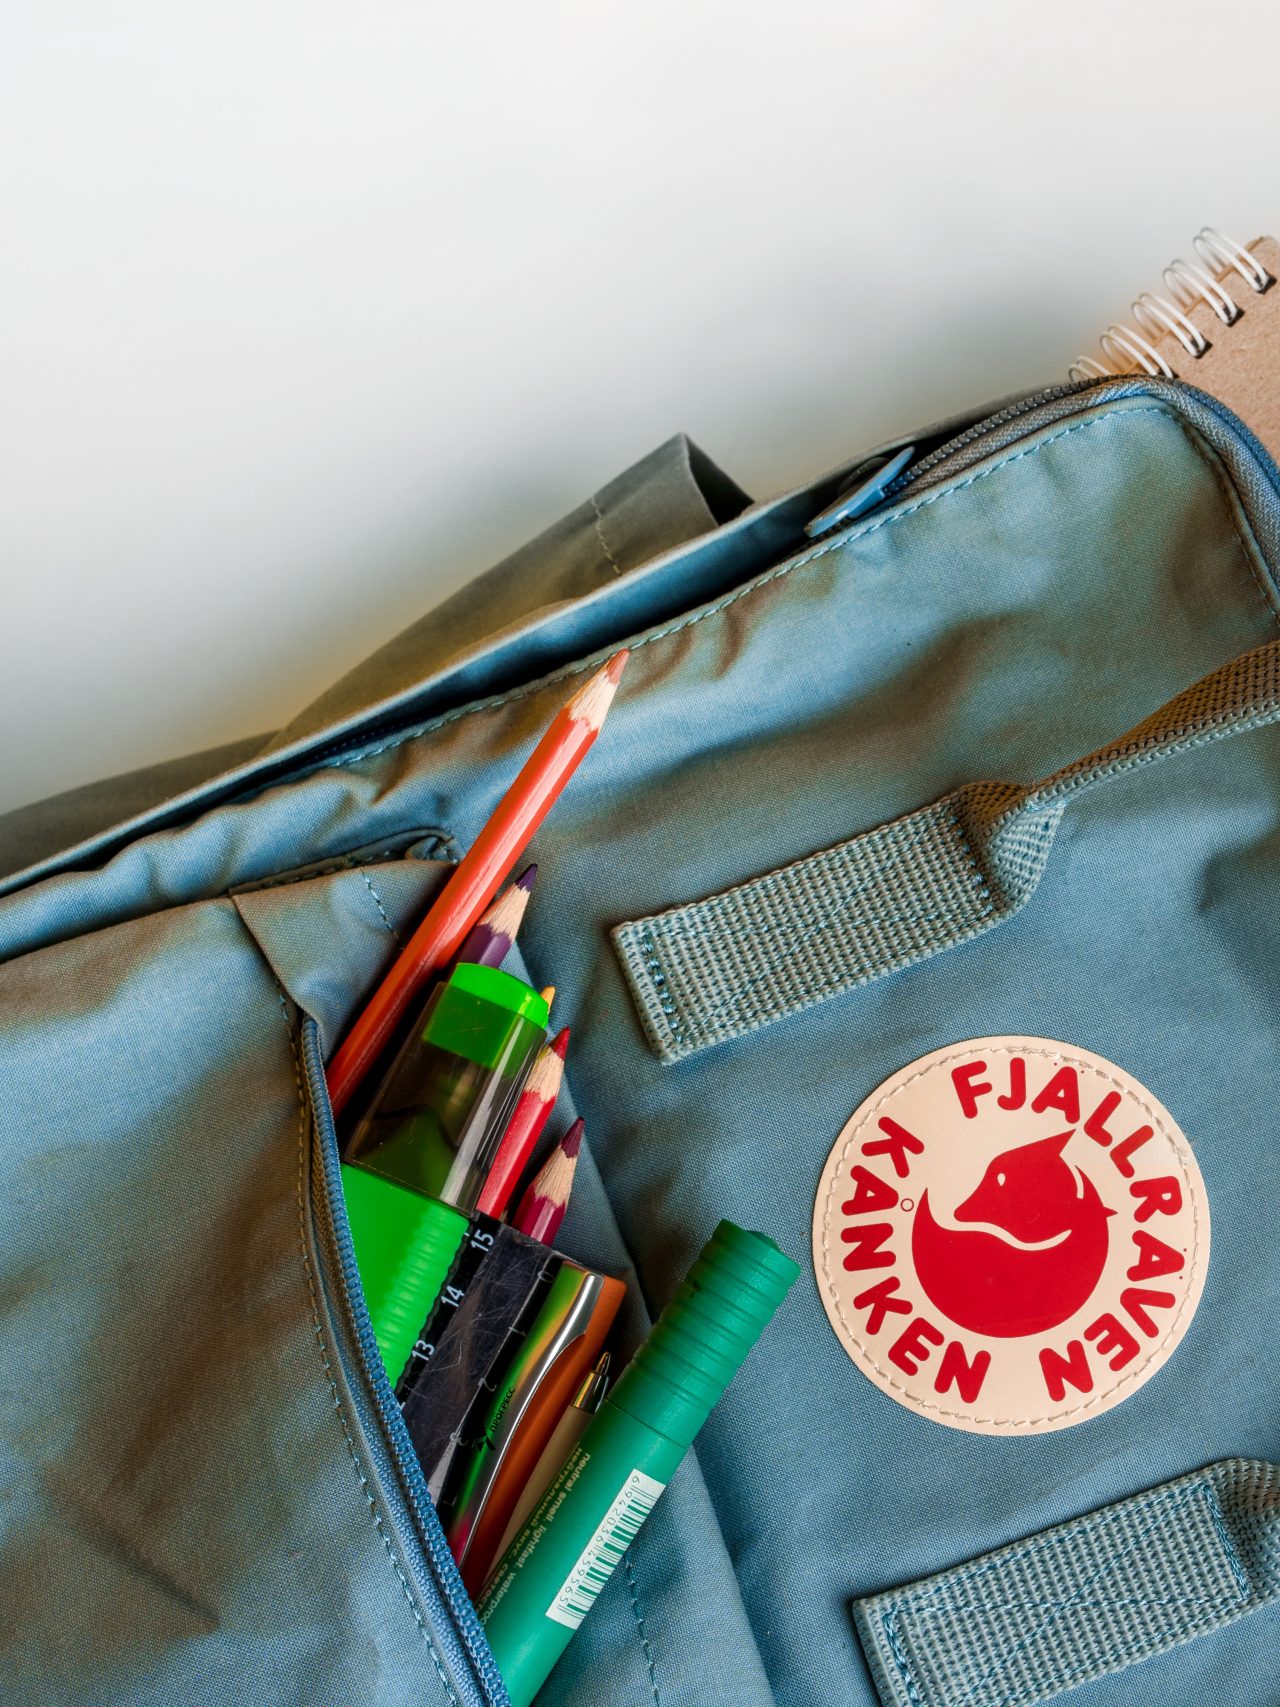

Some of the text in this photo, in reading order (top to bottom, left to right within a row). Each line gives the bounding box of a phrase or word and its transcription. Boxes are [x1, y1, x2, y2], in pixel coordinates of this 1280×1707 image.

[412, 1229, 494, 1361] 13 14 15
[490, 1386, 515, 1432] ПРОГРЕСС
[566, 1453, 591, 1491] neutral
[479, 1572, 517, 1626] waterproo
